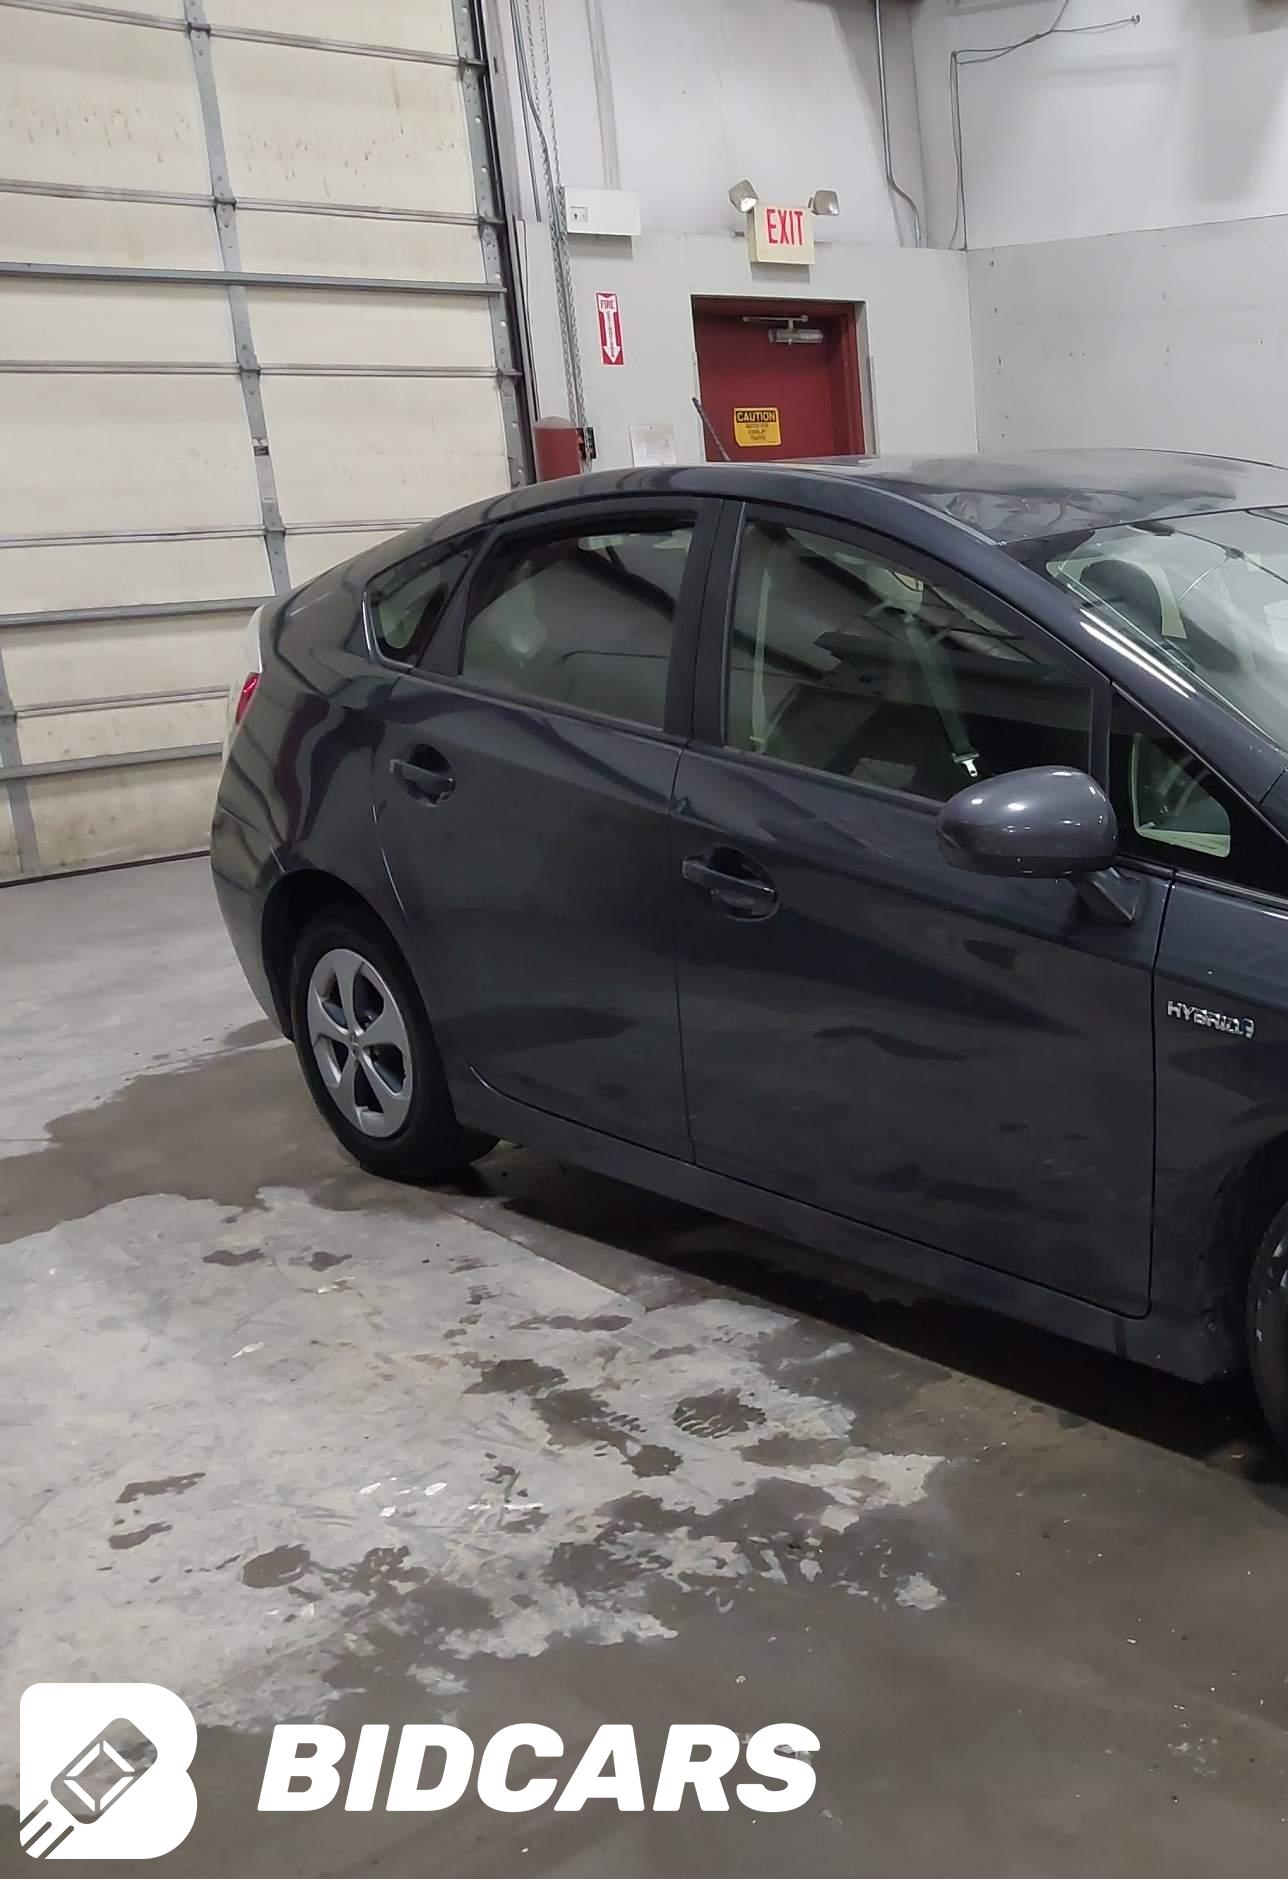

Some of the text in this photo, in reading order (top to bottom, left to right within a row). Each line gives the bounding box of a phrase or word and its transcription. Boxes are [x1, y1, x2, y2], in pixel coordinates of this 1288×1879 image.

[766, 208, 804, 246] EXIT
[600, 299, 615, 310] FIRE
[737, 411, 776, 422] CAUTION
